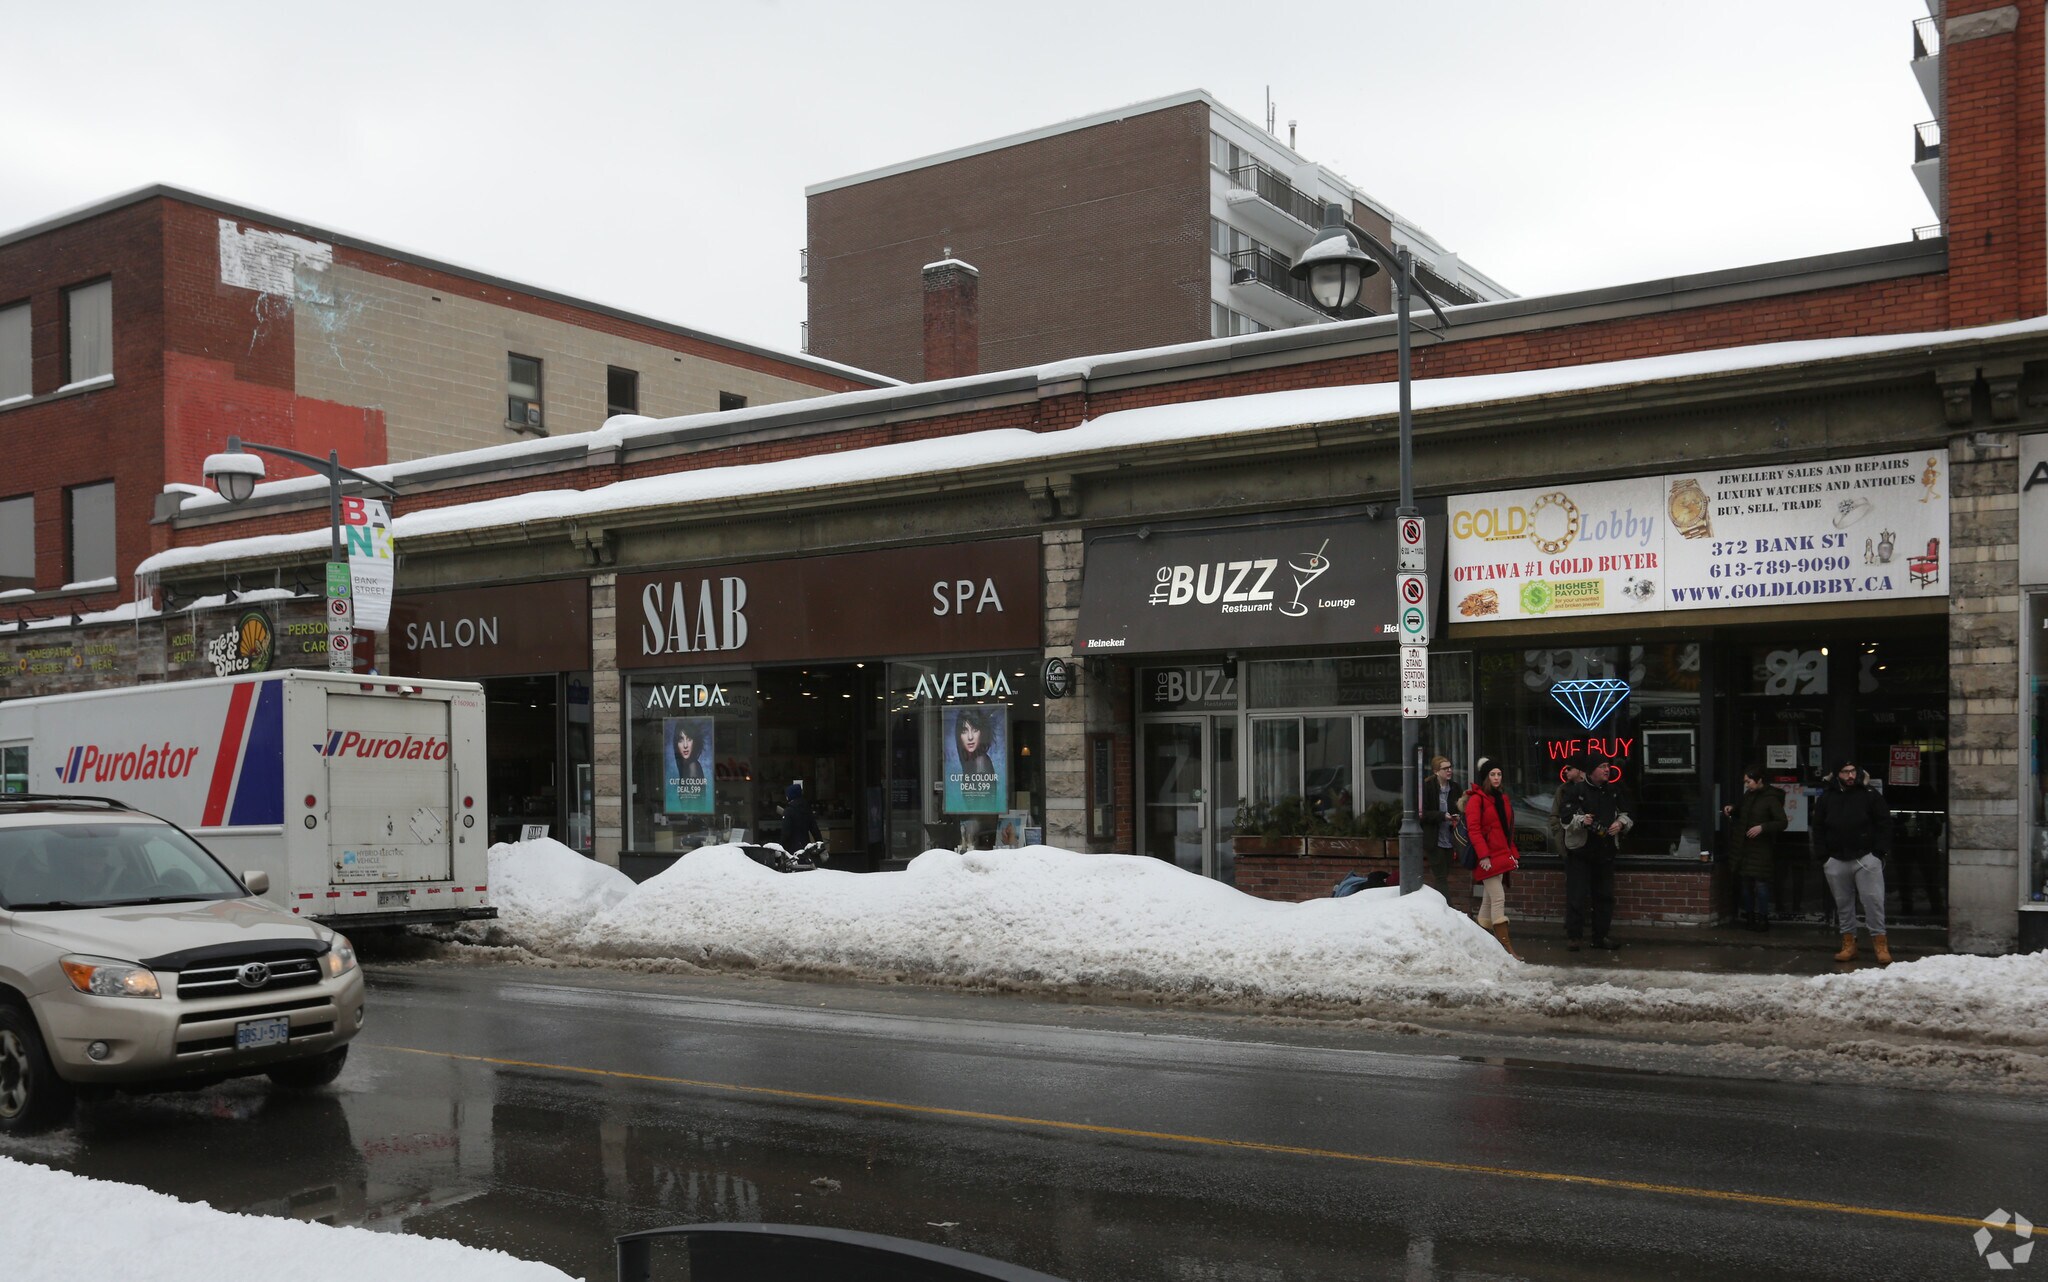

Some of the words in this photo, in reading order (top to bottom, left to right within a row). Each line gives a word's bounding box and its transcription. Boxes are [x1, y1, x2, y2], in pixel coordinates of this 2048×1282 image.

[1717, 471, 1784, 485] JEWELLERY
[1787, 467, 1823, 480] SALES
[1826, 464, 1851, 476] AND
[1854, 459, 1910, 473] REPAIRS
[1717, 487, 1763, 500] LUXURY
[1766, 483, 1822, 497] WATCHES
[1825, 480, 1850, 492] AND
[1854, 475, 1915, 489] ANTIQUES
[1717, 505, 1744, 517] BUY,
[1747, 503, 1779, 515] SELL,
[1782, 499, 1822, 512] TRADE
[1452, 506, 1527, 540] GOLD
[1578, 508, 1654, 547] Lobby
[1711, 540, 1749, 557] 372
[1755, 535, 1814, 554] BANK
[1821, 533, 1848, 549] ST
[1454, 563, 1520, 582] OTTAWA
[1524, 561, 1543, 577] #1
[1549, 557, 1593, 576] GOLD
[1599, 552, 1658, 572] BUYER
[1709, 556, 1850, 579] 613-789-9090
[354, 577, 378, 585] BANK
[354, 586, 385, 595] STREET
[1148, 565, 1172, 606] the
[1168, 558, 1278, 606] BUZZ
[1554, 581, 1600, 590] HIGHEST
[1671, 576, 1893, 603] WWW.GOLDLOBBY.CA
[932, 577, 1004, 617] SPA
[1318, 597, 1356, 610] Lounge
[1554, 588, 1600, 597] PAYOUTS
[642, 576, 748, 656] SAAB
[1221, 602, 1273, 614] Restaurant
[288, 623, 329, 636] PERSON
[406, 617, 499, 651] SALON
[85, 643, 118, 656] NATURAL
[208, 626, 240, 656] Herb
[1087, 638, 1126, 649] Heineken
[91, 659, 113, 670] WEAR
[208, 653, 249, 677] Spice
[1405, 659, 1422, 667] STAND
[914, 669, 1012, 700] AVEDA
[1168, 669, 1238, 702] BUZZ
[1404, 671, 1425, 679] STATION
[646, 683, 726, 709] AVEDA
[1587, 737, 1634, 759] BUY
[1894, 751, 1916, 761] OPEN
[79, 741, 199, 784] Purolator
[951, 774, 964, 782] CUT
[964, 774, 970, 782] &
[971, 773, 999, 782] COLOUR
[960, 782, 977, 791] DEAL
[978, 782, 991, 791] $99
[690, 786, 702, 794] $99
